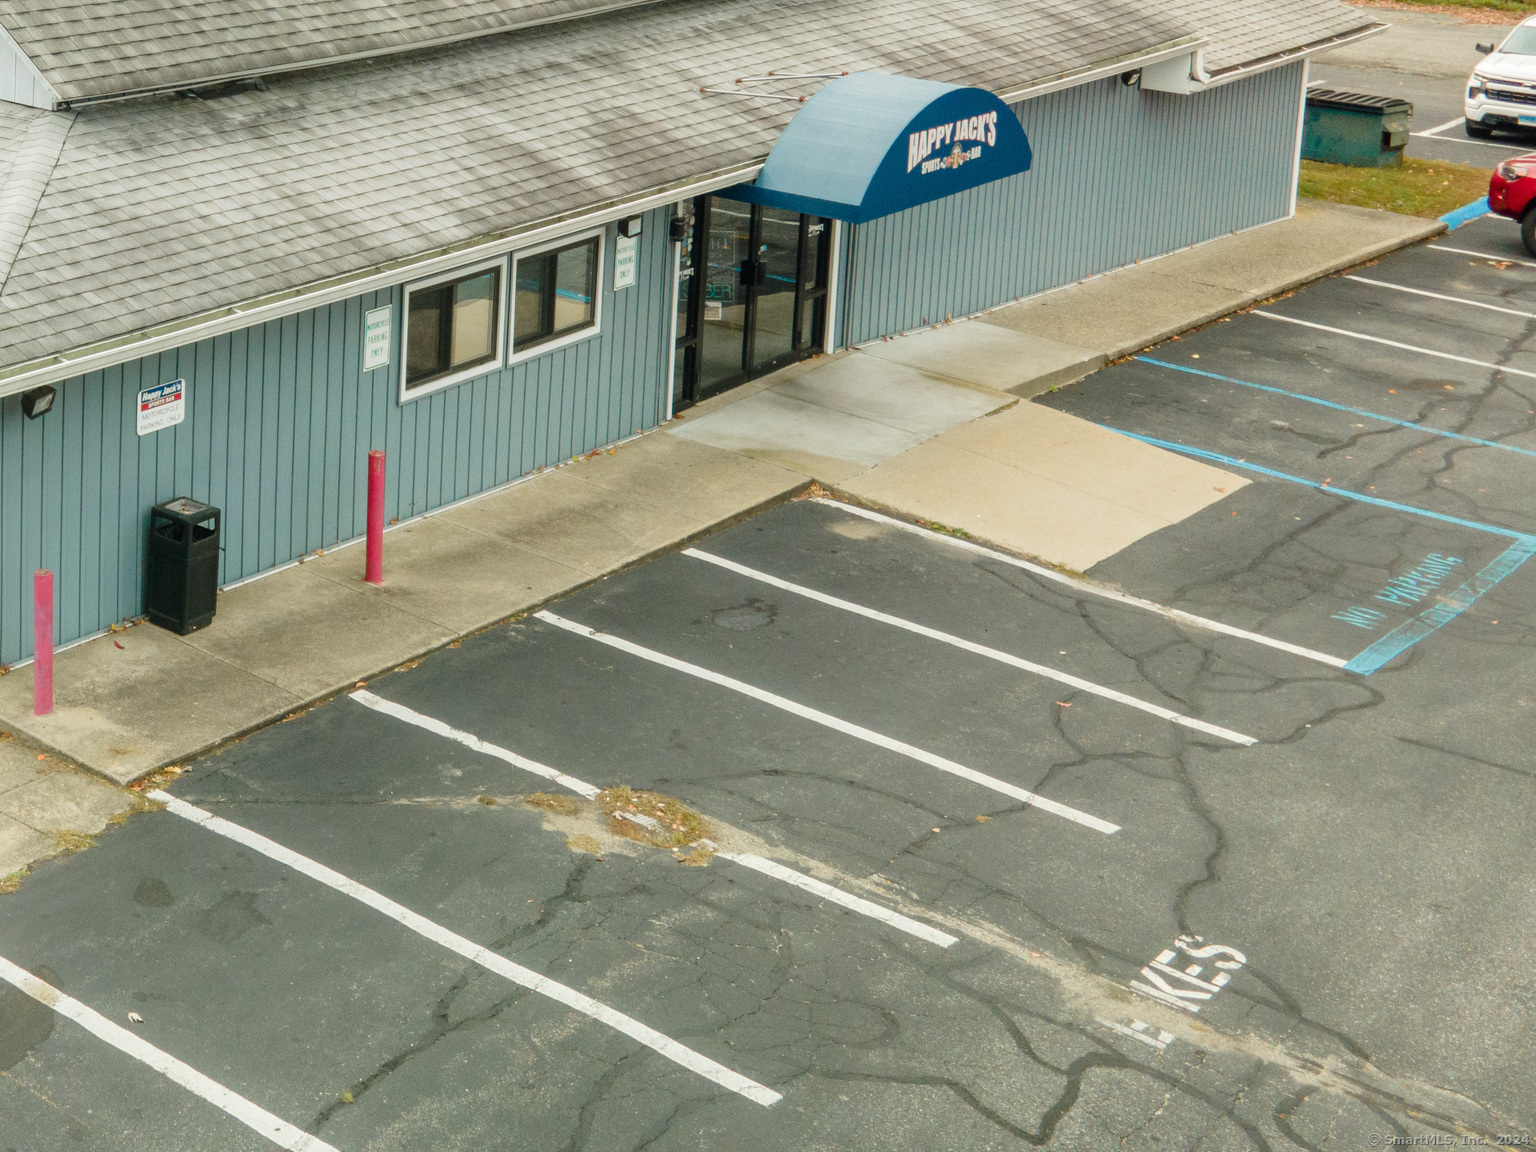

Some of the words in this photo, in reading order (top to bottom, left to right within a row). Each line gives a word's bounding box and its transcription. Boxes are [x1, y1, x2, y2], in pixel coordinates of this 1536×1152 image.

[907, 122, 954, 174] HAPPY
[954, 110, 997, 147] JACK'S
[921, 158, 940, 175] SPORTS
[971, 146, 981, 160] BAR
[368, 331, 388, 344] PARKING
[371, 347, 383, 358] ONLY
[142, 390, 162, 401] Happy
[162, 383, 181, 395] Jack's
[142, 404, 179, 420] MOTORCYCLE
[141, 419, 164, 431] PARKING
[167, 414, 181, 423] ONLY
[1331, 606, 1387, 630] NO
[1375, 553, 1463, 606] PARKING
